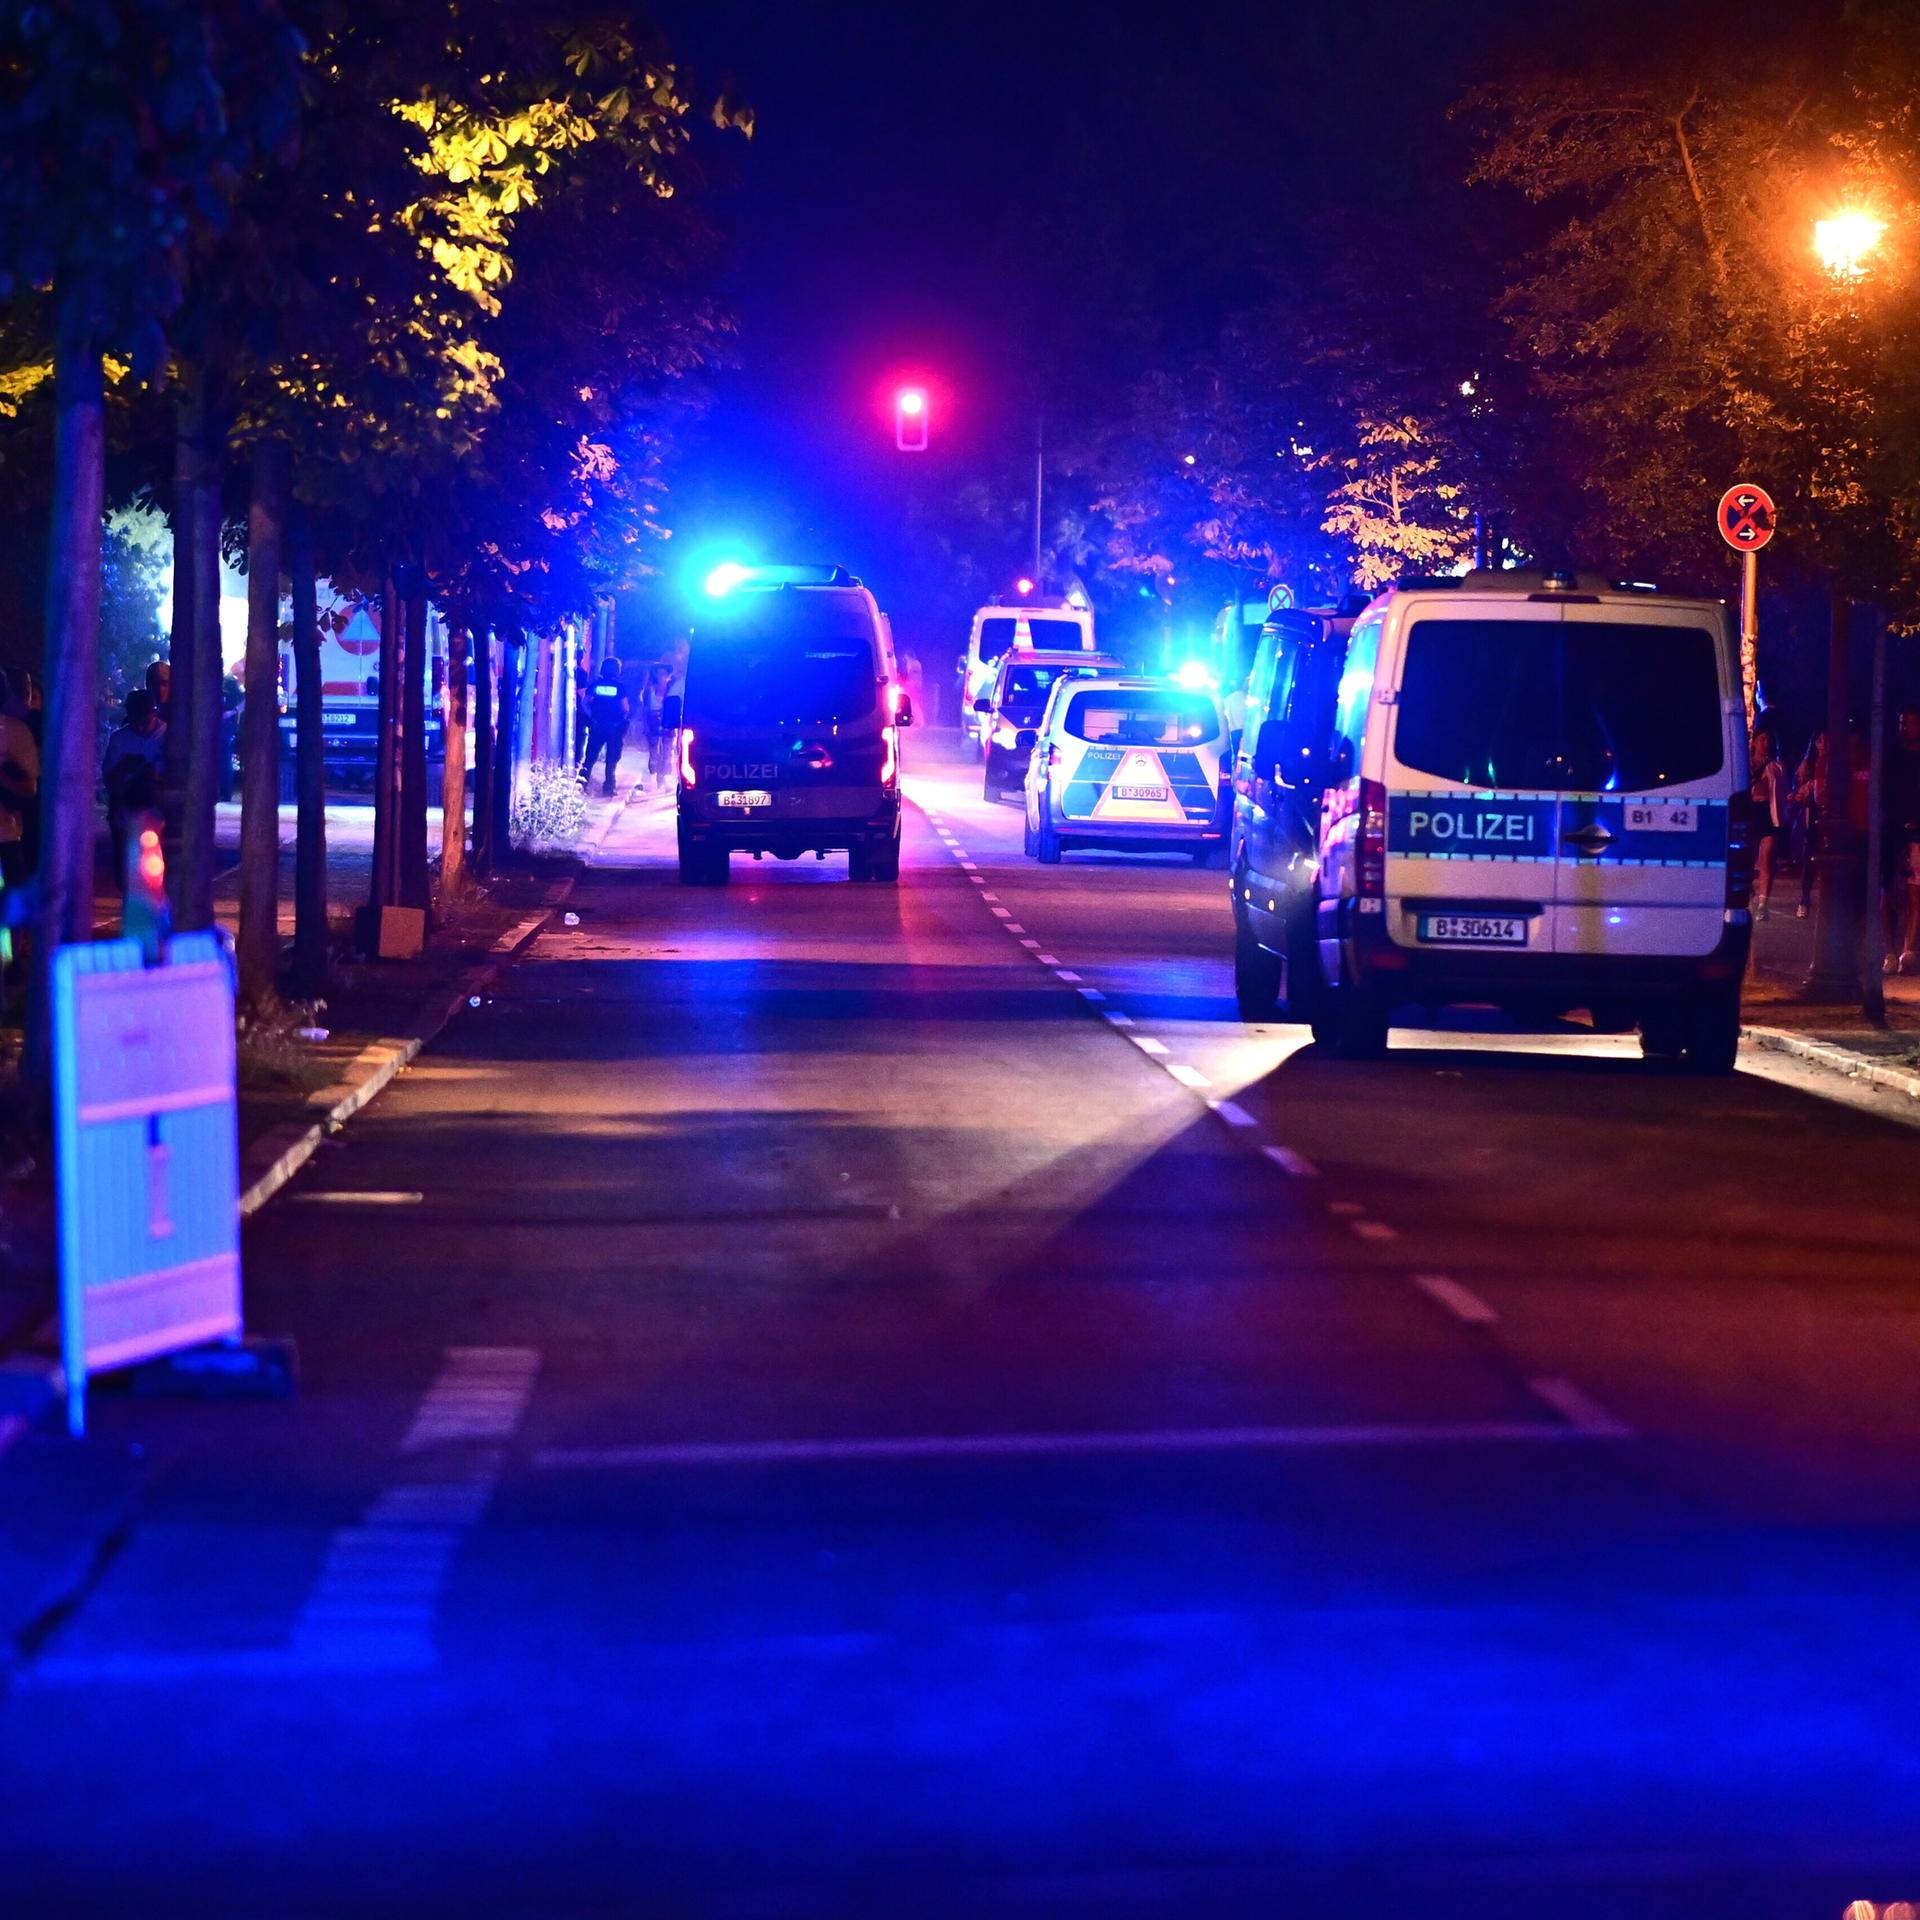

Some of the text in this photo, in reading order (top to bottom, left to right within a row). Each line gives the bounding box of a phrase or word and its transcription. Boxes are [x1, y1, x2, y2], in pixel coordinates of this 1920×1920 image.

[1087, 751, 1121, 760] POLIZEI
[704, 763, 779, 779] POLIZEI
[1632, 809, 1688, 825] B1 42
[1408, 811, 1534, 841] POLIZEI
